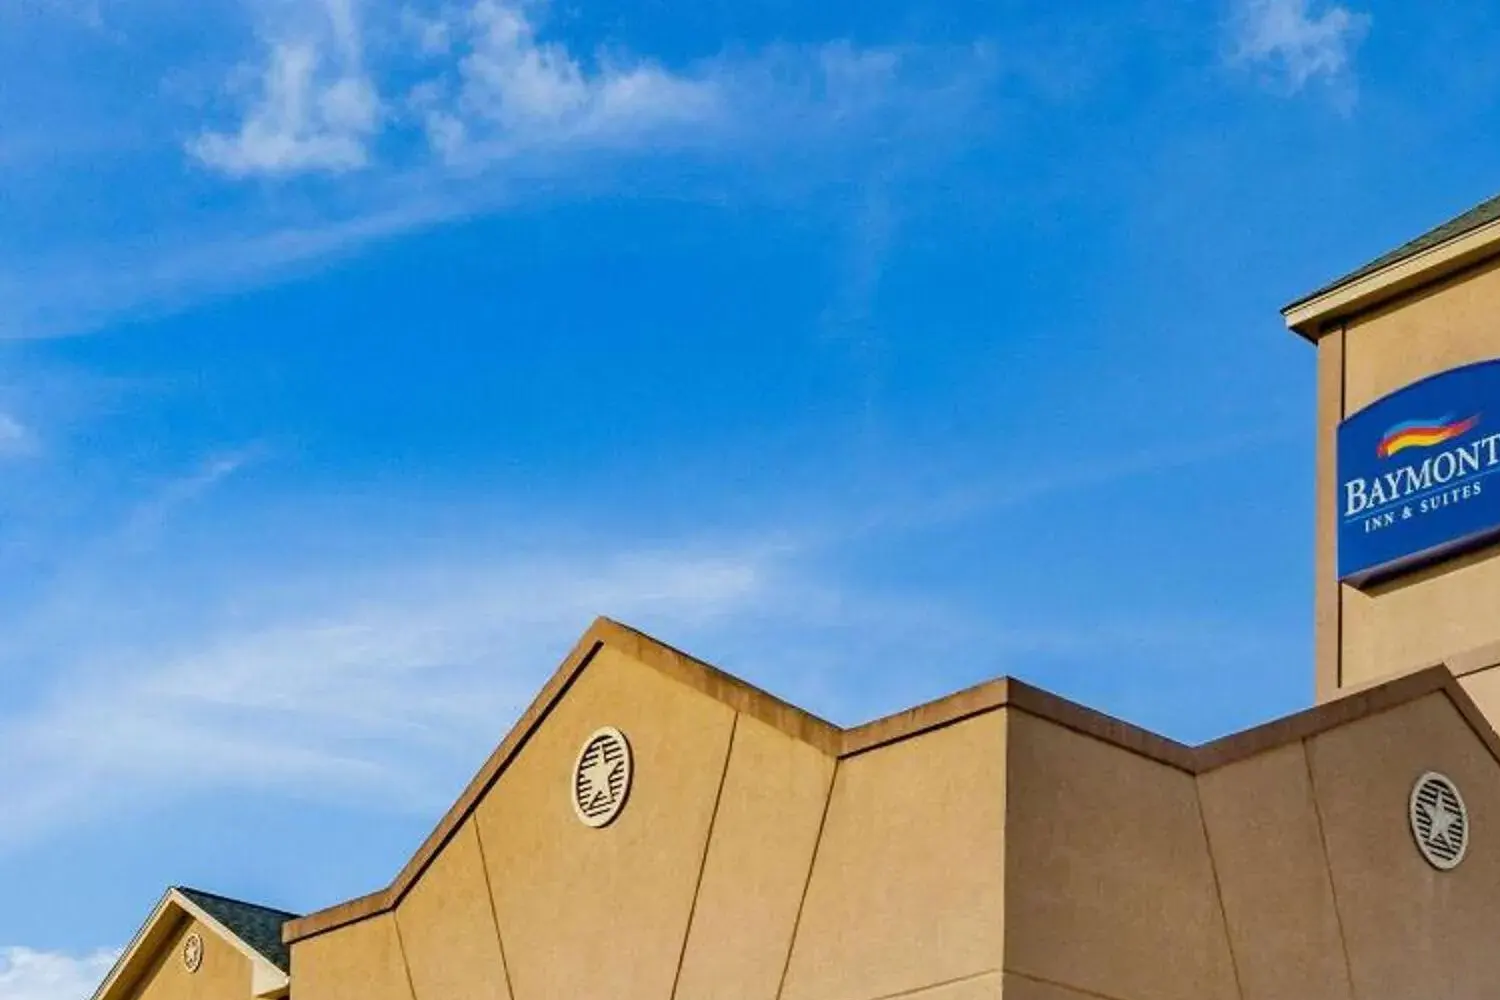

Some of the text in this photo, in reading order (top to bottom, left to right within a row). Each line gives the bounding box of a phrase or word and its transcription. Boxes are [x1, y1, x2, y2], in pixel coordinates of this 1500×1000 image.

[1364, 481, 1483, 534] INN & SUITES
